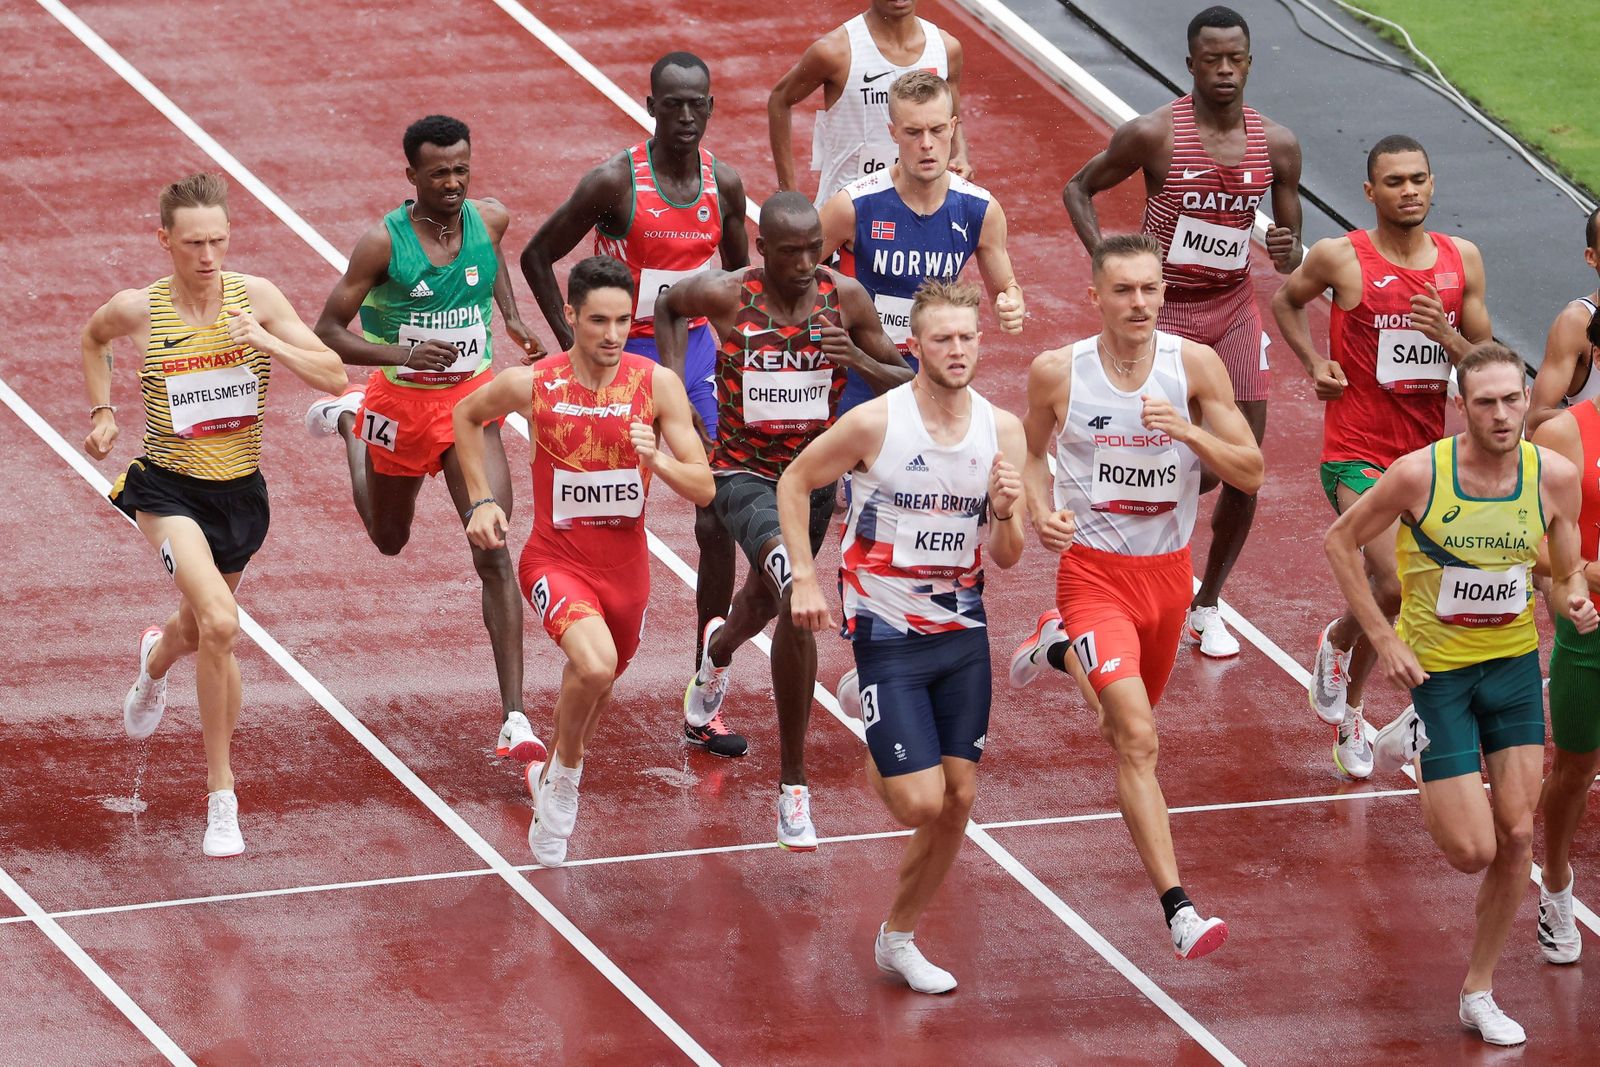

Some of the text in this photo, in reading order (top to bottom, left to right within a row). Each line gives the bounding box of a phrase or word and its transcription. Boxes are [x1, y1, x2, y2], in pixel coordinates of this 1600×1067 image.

[864, 158, 886, 174] de
[1183, 192, 1259, 212] QATAR
[644, 231, 712, 240] SOUTH SUDAN
[873, 249, 964, 277] NORWAY
[410, 304, 482, 329] ETHIOPIA
[407, 338, 479, 357] TRA
[1392, 344, 1450, 365] SADIK
[162, 348, 245, 373] GERMANY
[744, 349, 830, 369] KENYA
[172, 381, 257, 406] BARTELSMEYER
[749, 385, 826, 403] CHERUIYOT
[552, 402, 632, 418] ESPAÑA
[366, 415, 391, 446] 14
[1088, 416, 1112, 429] 4F
[1094, 434, 1172, 448] POLSKA
[1099, 463, 1176, 488] ROZMYS
[562, 483, 639, 503] FONTES
[894, 492, 938, 510] GREAT
[915, 531, 965, 552] KERR
[1443, 536, 1526, 549] AUSTRALIA
[1453, 579, 1518, 602] HOARE
[1100, 657, 1121, 674] 4F
